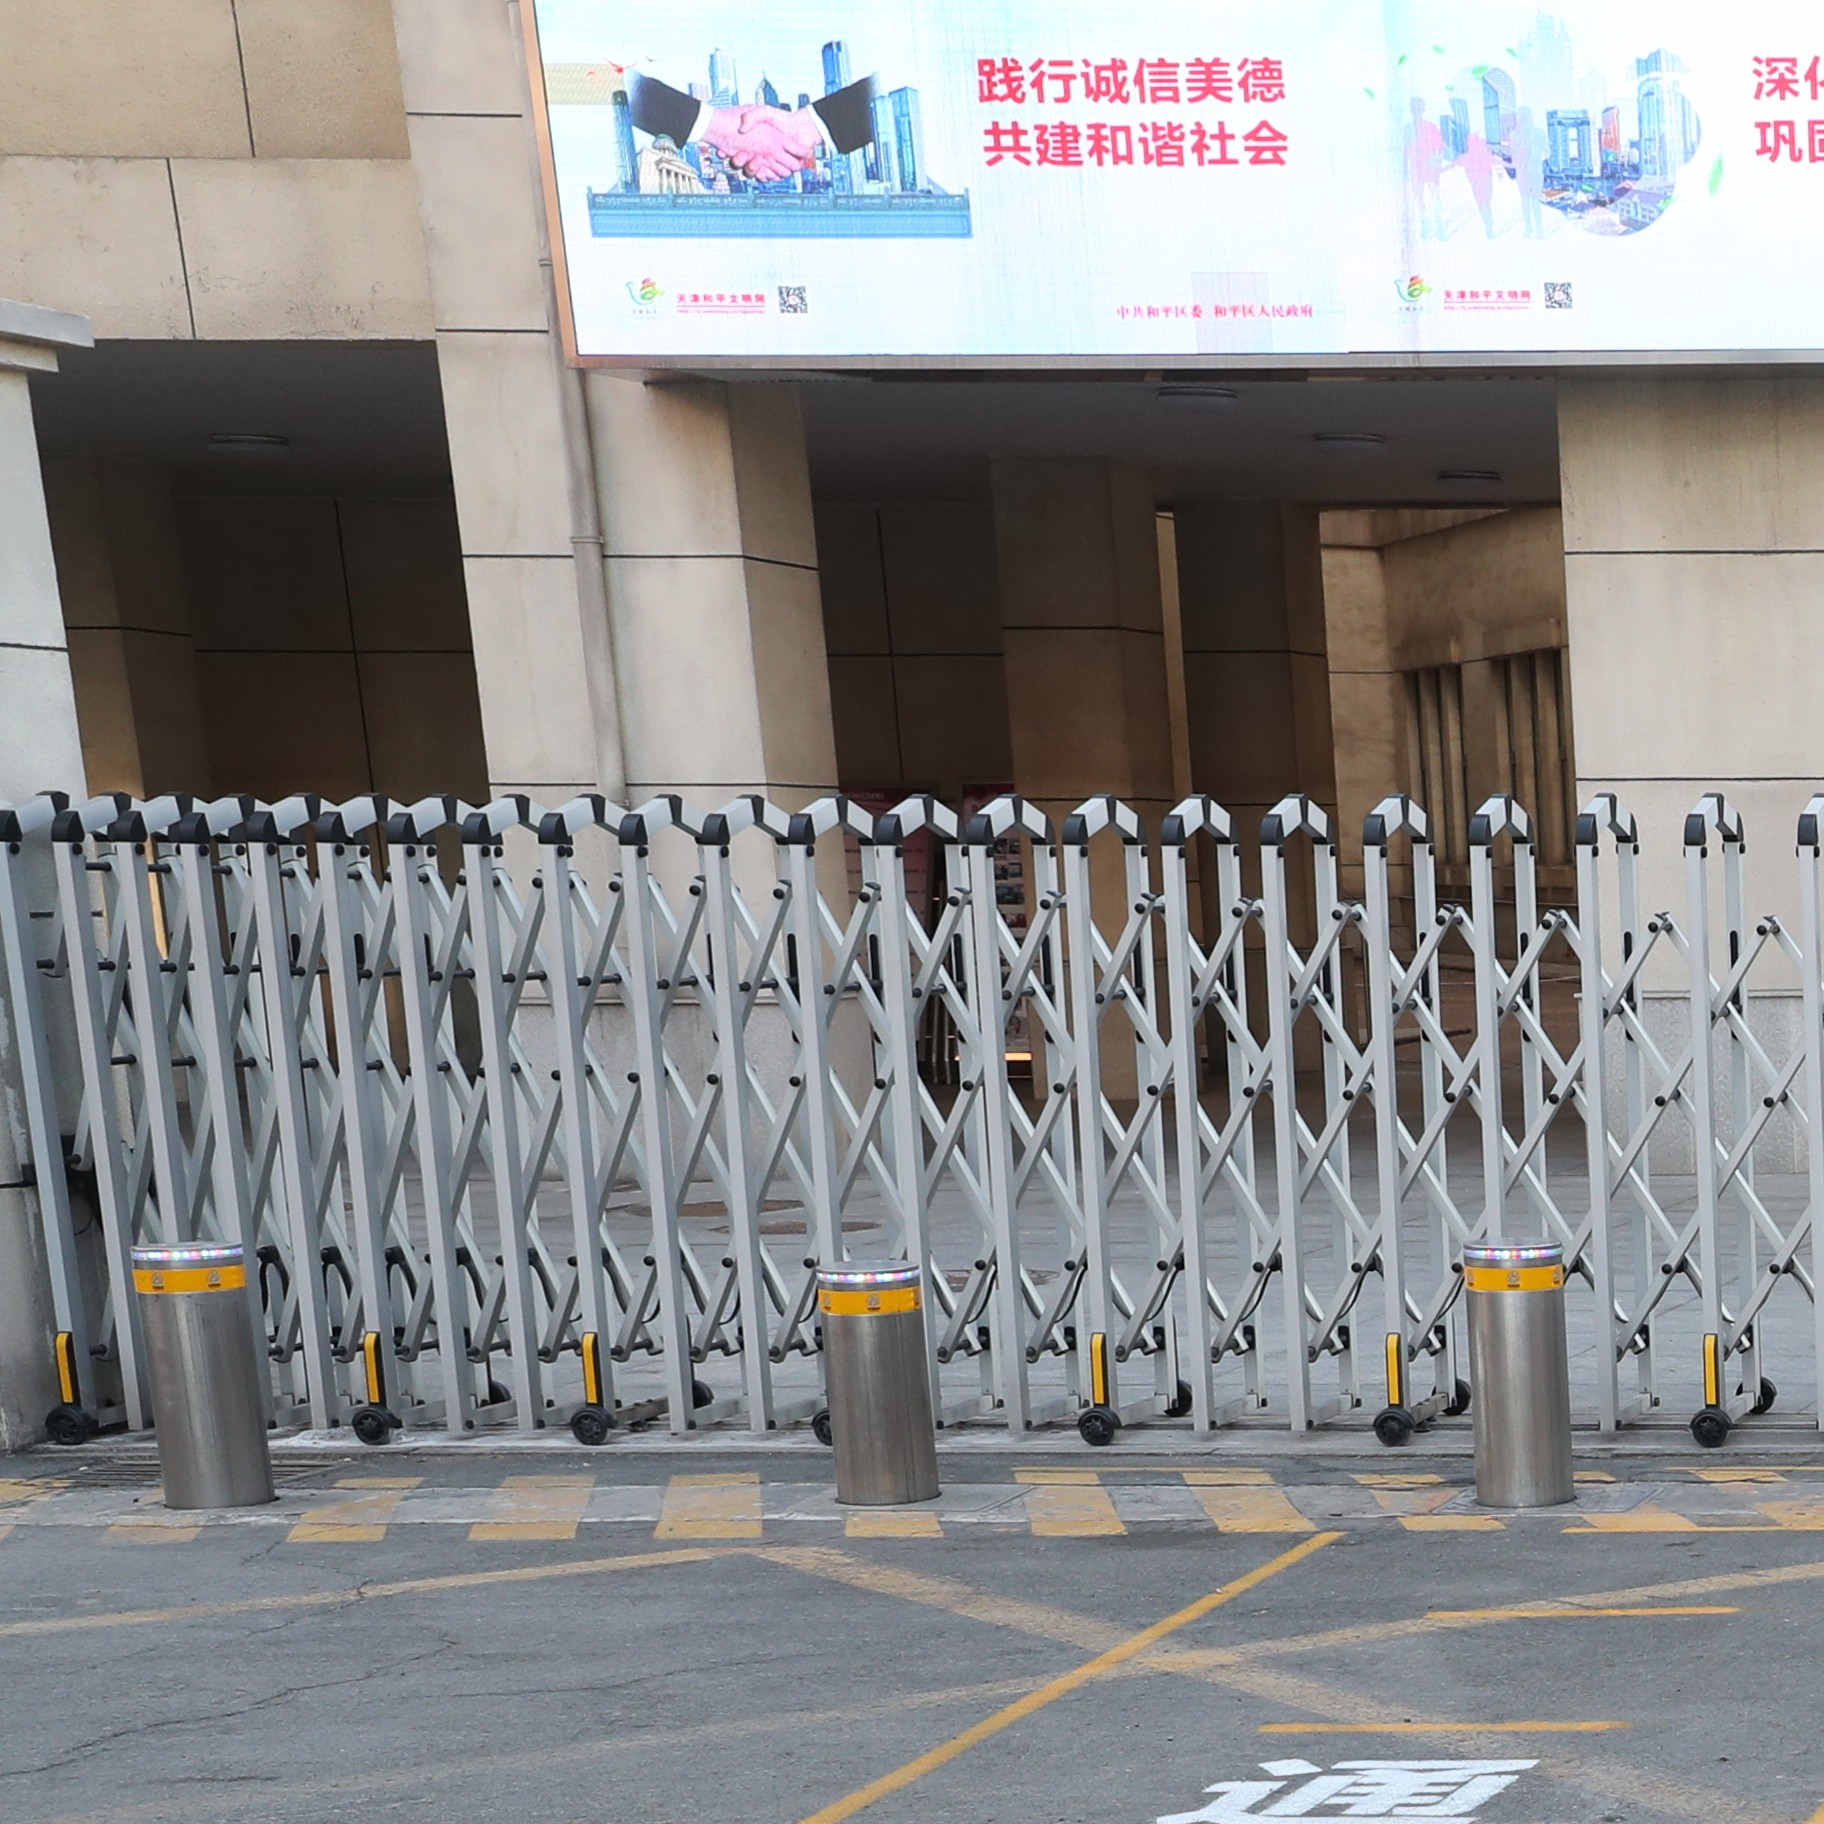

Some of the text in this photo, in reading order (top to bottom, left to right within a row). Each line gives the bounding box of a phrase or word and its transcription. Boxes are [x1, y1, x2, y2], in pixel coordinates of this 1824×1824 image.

[977, 57, 1286, 105] 践行诚信美德
[982, 119, 1289, 167] 共建和谐社会
[1117, 304, 1313, 319] 中共和平区委 和平区人民政府
